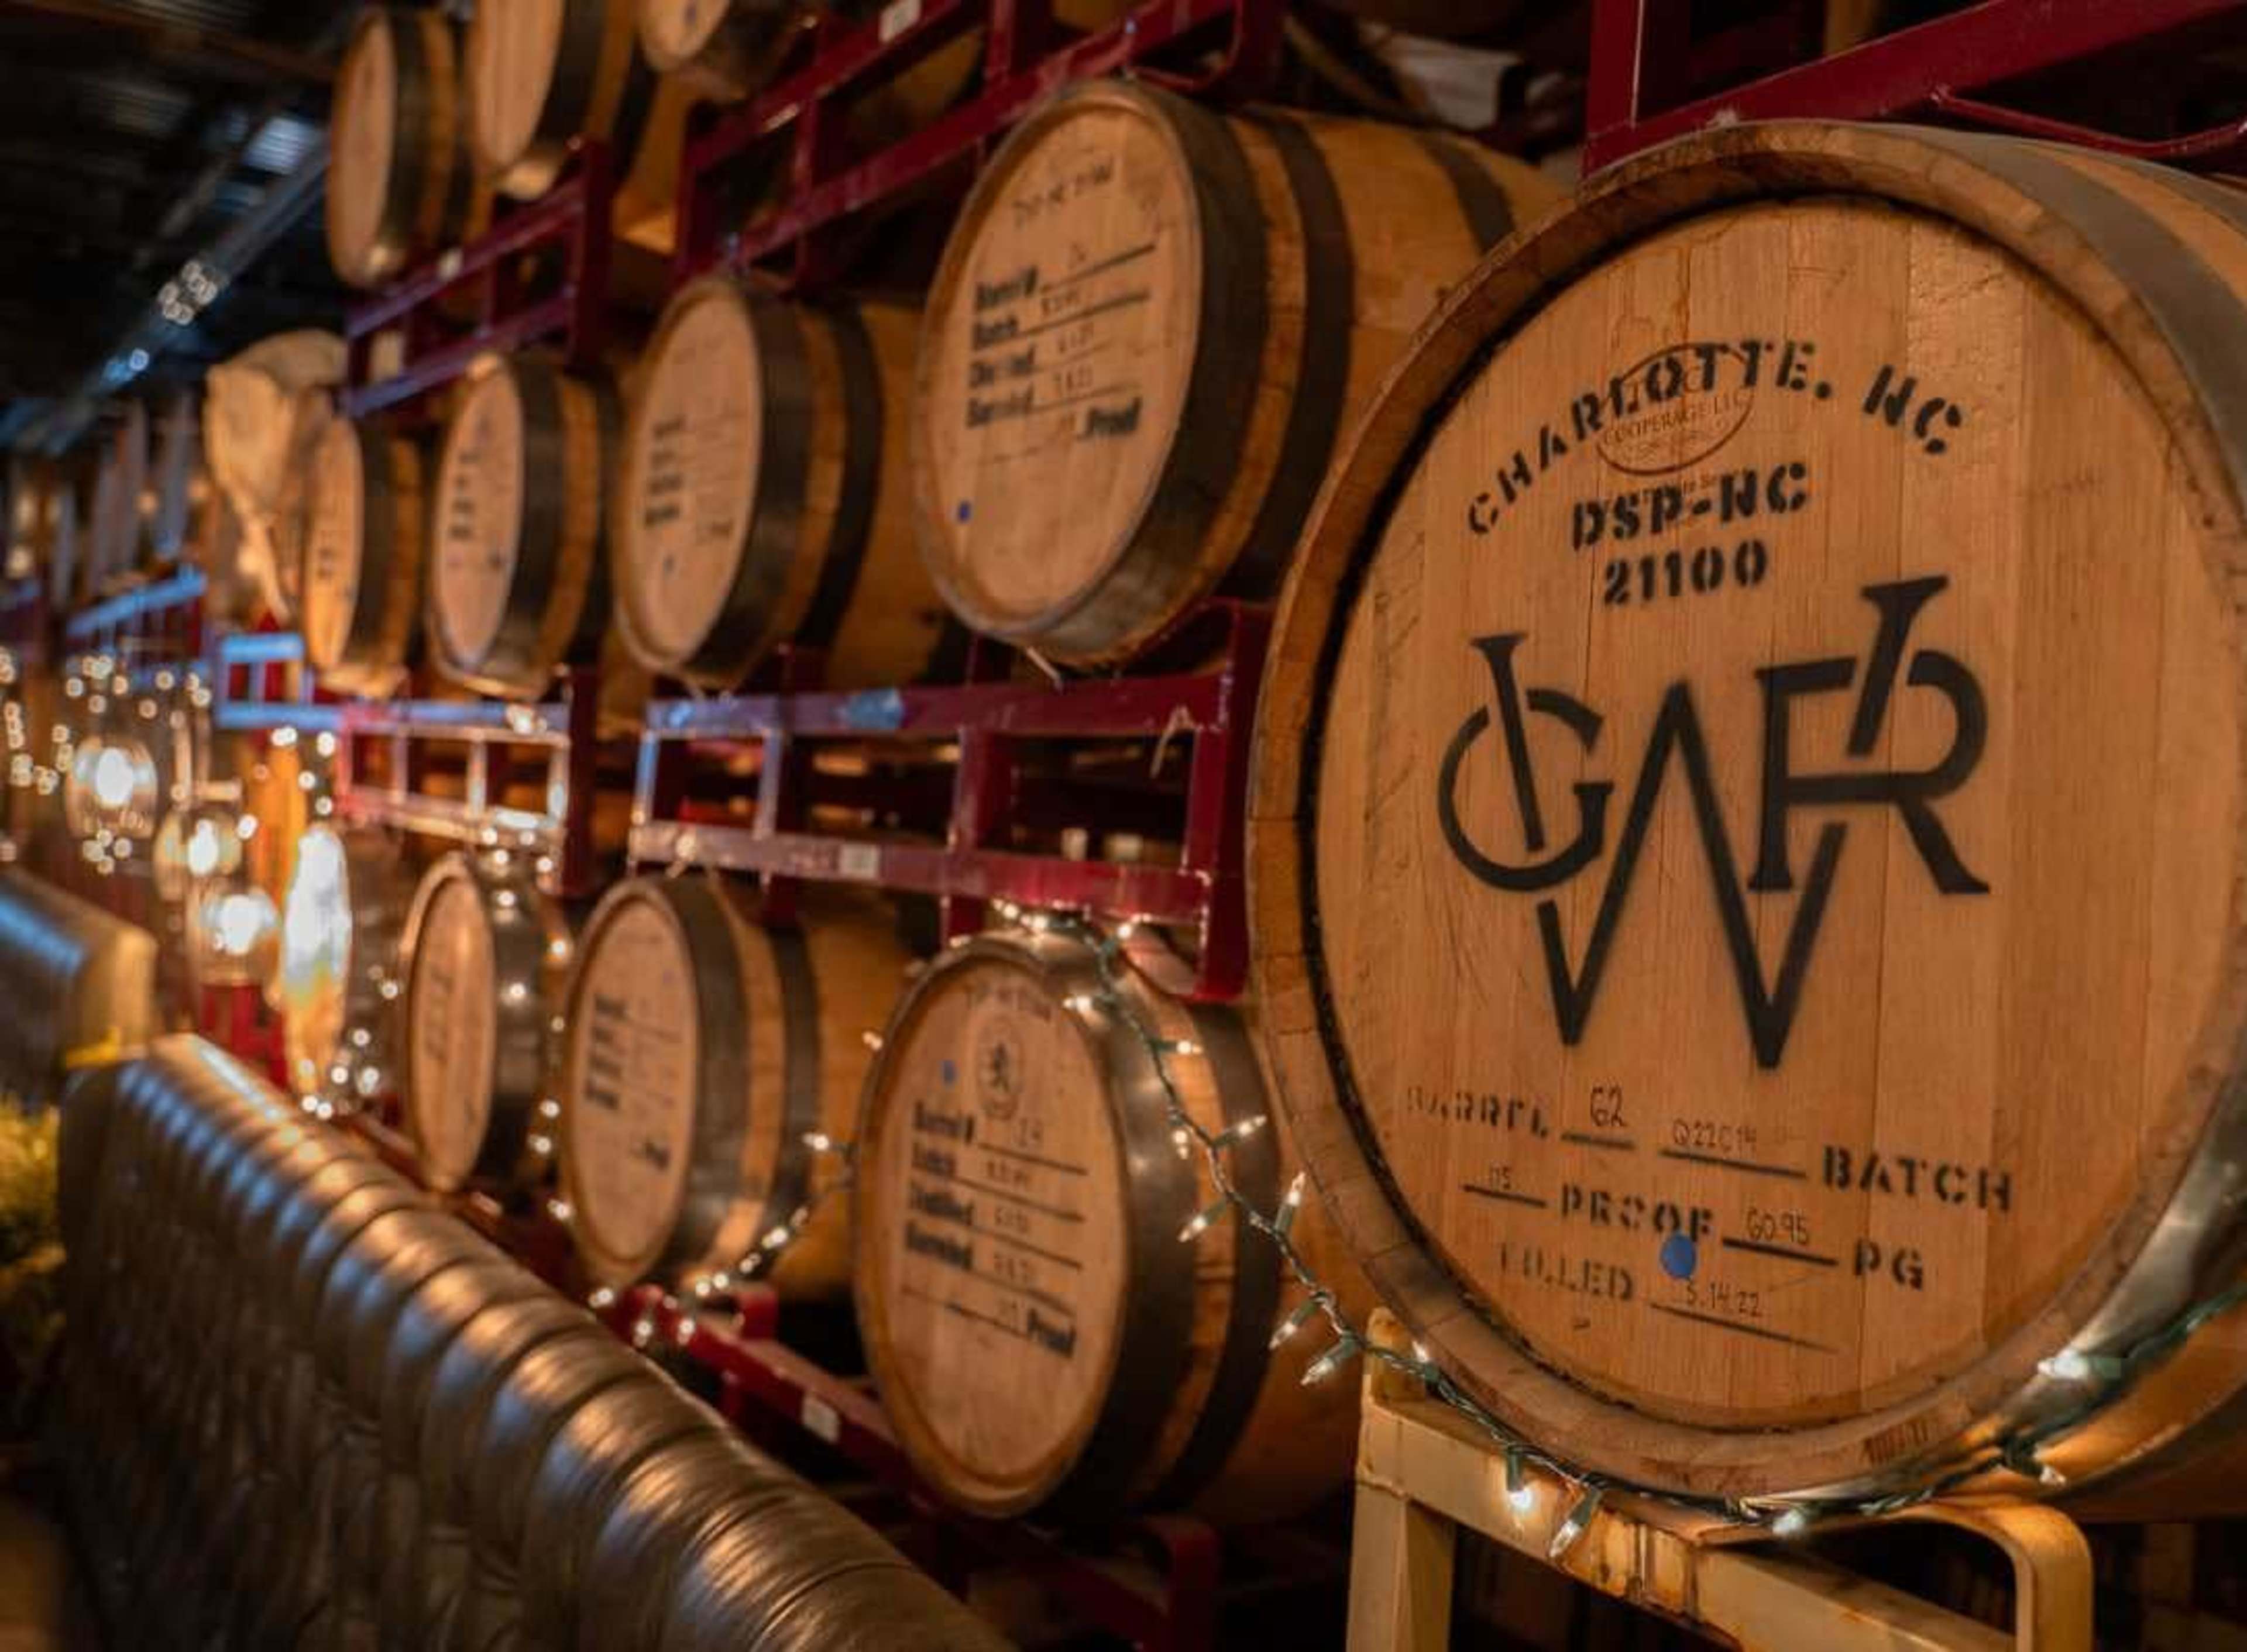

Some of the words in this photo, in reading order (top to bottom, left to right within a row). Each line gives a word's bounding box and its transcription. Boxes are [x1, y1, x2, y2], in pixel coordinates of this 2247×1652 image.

[1863, 364, 1963, 455] NC
[1571, 462, 1809, 550] DSP-NC
[1603, 539, 1767, 605] 21100
[1561, 1183, 1715, 1241] PROOF
[1823, 1145, 2013, 1213] BATCH
[1853, 1237, 1924, 1290] PG
